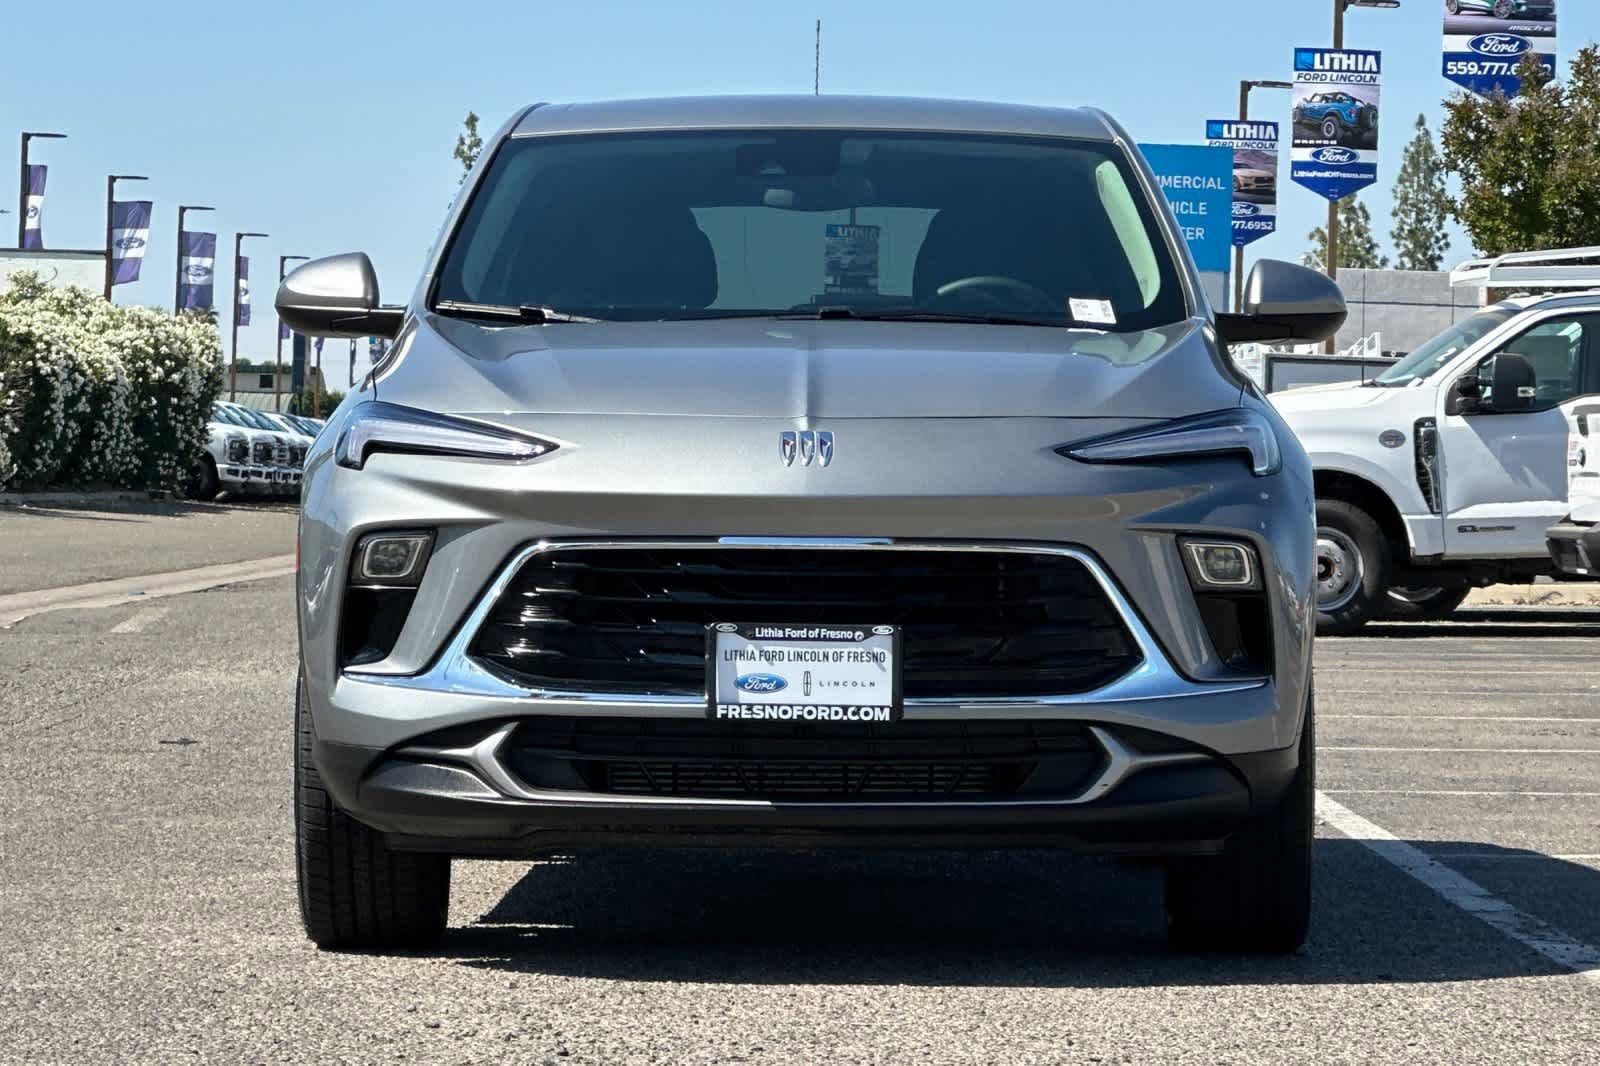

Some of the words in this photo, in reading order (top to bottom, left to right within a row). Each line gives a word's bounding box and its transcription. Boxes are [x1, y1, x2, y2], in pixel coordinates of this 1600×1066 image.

[1480, 36, 1519, 53] Ford
[1314, 52, 1378, 72] LITHIA
[1447, 61, 1552, 76] 559.777.62
[1297, 72, 1328, 82] FORD
[1330, 73, 1377, 83] LINCOLN
[1223, 123, 1276, 140] LITHIA
[1236, 141, 1276, 149] LINCOLN
[1319, 149, 1352, 162] Ford
[755, 627, 783, 638] Lithia
[785, 628, 807, 638] Ford
[809, 628, 819, 639] of
[820, 629, 853, 640] Fresno
[724, 649, 756, 662] LITHIA
[758, 650, 785, 662] FORD
[787, 650, 829, 663] LINCOLN
[832, 650, 845, 663] OF
[847, 650, 886, 664] FRESNO
[743, 675, 776, 691] Ford
[716, 705, 890, 721] FRESNOFORD.COM
